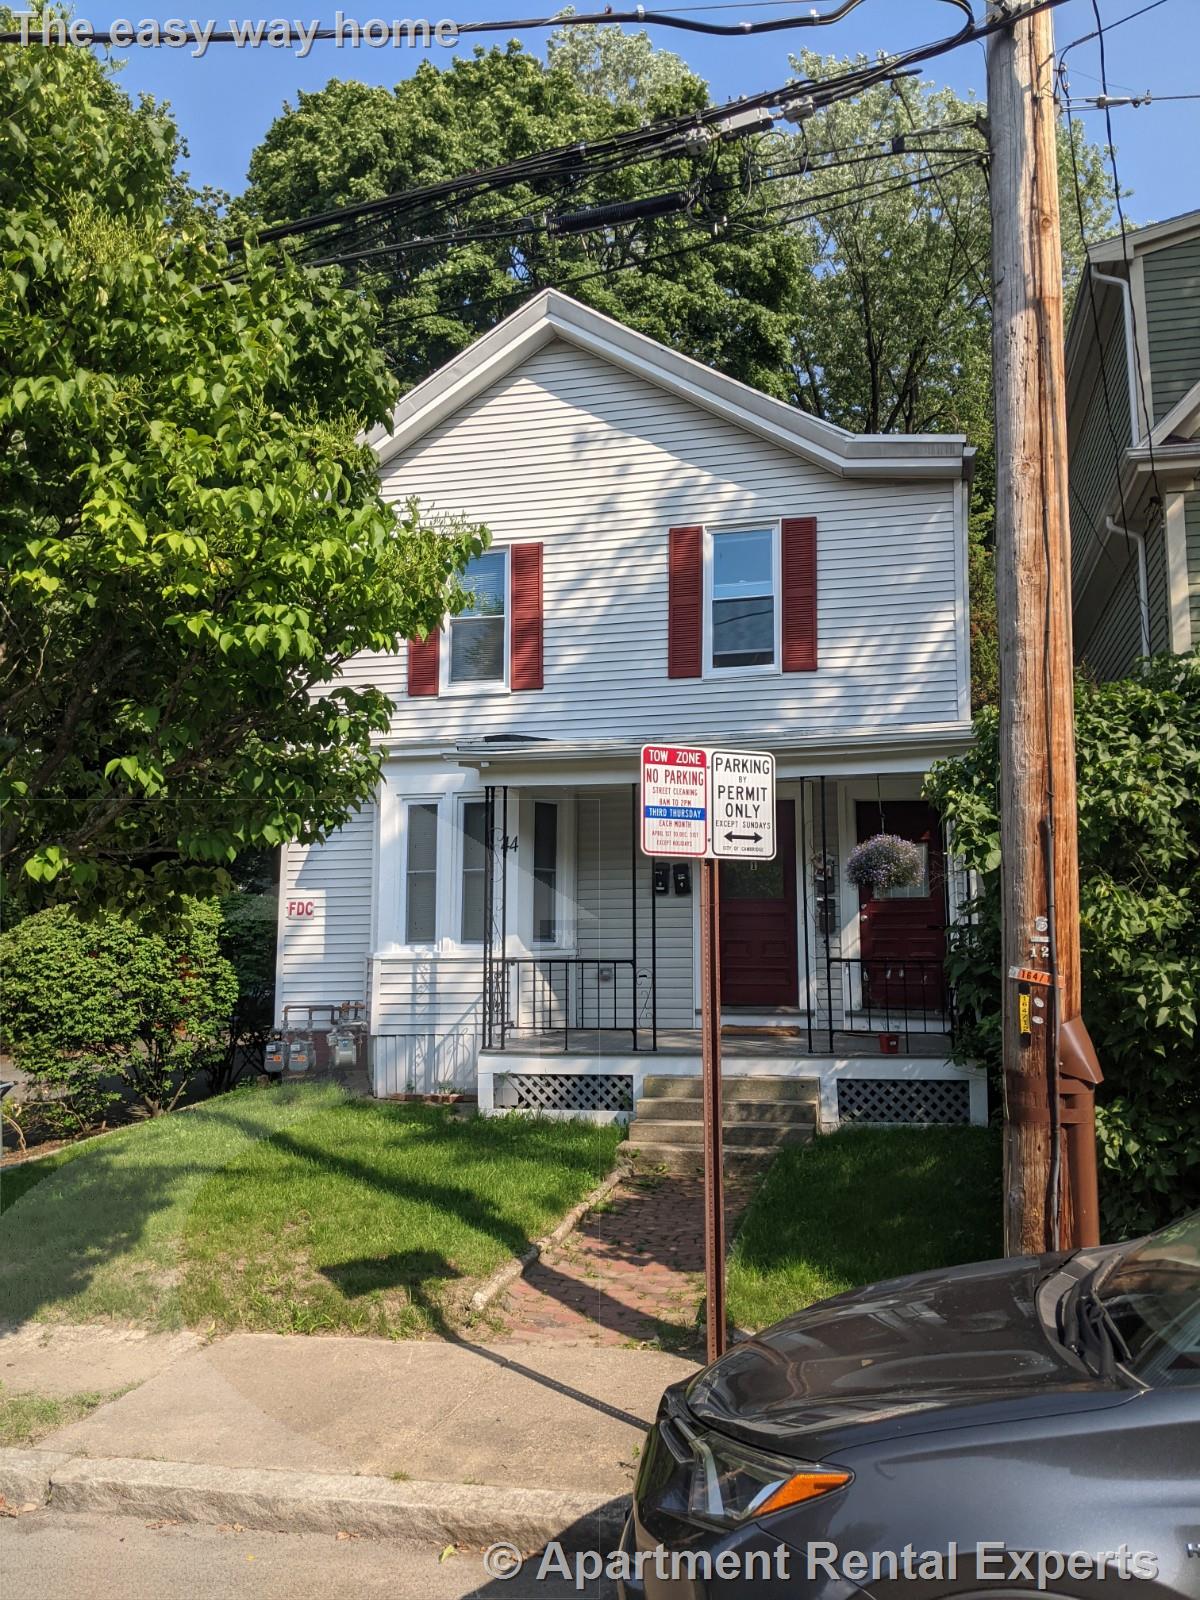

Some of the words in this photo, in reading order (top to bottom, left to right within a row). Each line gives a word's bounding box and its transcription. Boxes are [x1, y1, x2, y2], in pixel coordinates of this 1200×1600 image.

[649, 749, 669, 762] TOW
[676, 751, 702, 764] ZONE
[715, 757, 770, 775] PARKING
[646, 768, 659, 783] NO
[664, 769, 704, 786] PARKING
[738, 775, 747, 783] BY
[652, 786, 671, 795] STREET
[673, 788, 698, 796] CLEANING
[718, 784, 768, 802] PERMIT
[681, 799, 692, 807] 2PM
[649, 807, 667, 817] THIRD
[670, 809, 702, 819] THURSDAY
[725, 802, 761, 819] ONLY
[659, 819, 672, 827] EACH
[715, 819, 738, 828] EXCEPT
[742, 820, 771, 830] SUNDAYS
[289, 901, 314, 916] FDC
